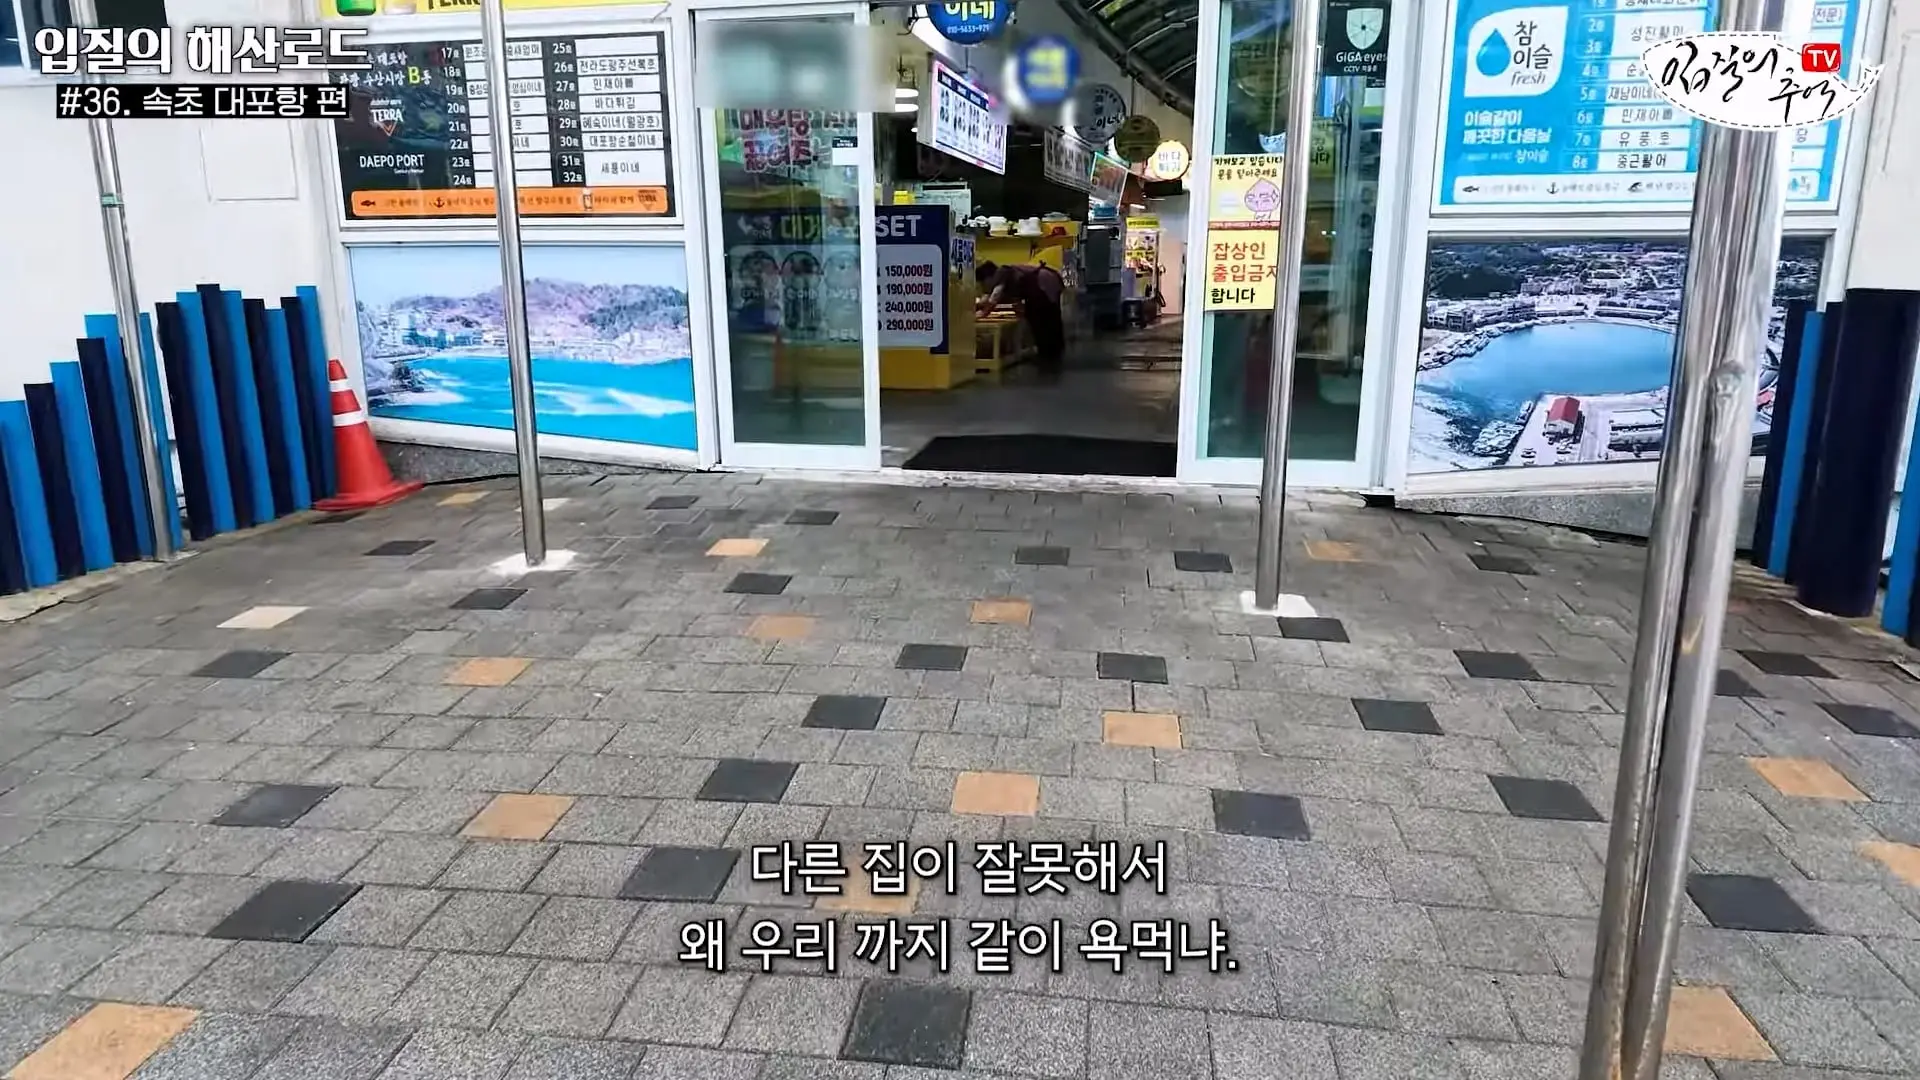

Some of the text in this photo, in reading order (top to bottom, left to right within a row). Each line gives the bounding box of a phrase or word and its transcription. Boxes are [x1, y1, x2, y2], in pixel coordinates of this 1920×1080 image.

[1513, 20, 1538, 46] 참
[552, 43, 572, 54] 25호
[1513, 44, 1552, 70] 이슬
[554, 62, 574, 72] 26호
[1343, 65, 1360, 73] CCTV
[363, 71, 405, 87] 수산시장
[408, 66, 432, 86] B동
[1511, 71, 1548, 87] fresh
[555, 81, 575, 92] 27호
[557, 99, 576, 111] 28호
[371, 109, 404, 123] TERRA
[1464, 109, 1522, 126] 이슬같이
[560, 118, 577, 128] 29호
[560, 136, 579, 147] 30호
[359, 154, 425, 168] DAEPO PORT
[561, 156, 581, 166] 31호
[563, 172, 583, 182] 32호
[875, 215, 921, 237] SET
[1213, 242, 1265, 261] 잡상인
[885, 264, 933, 278] 150,000원
[886, 283, 933, 296] 190,000원
[1211, 288, 1255, 304] 합니다
[885, 301, 934, 314] 240,000원
[886, 319, 934, 332] 290,000원
